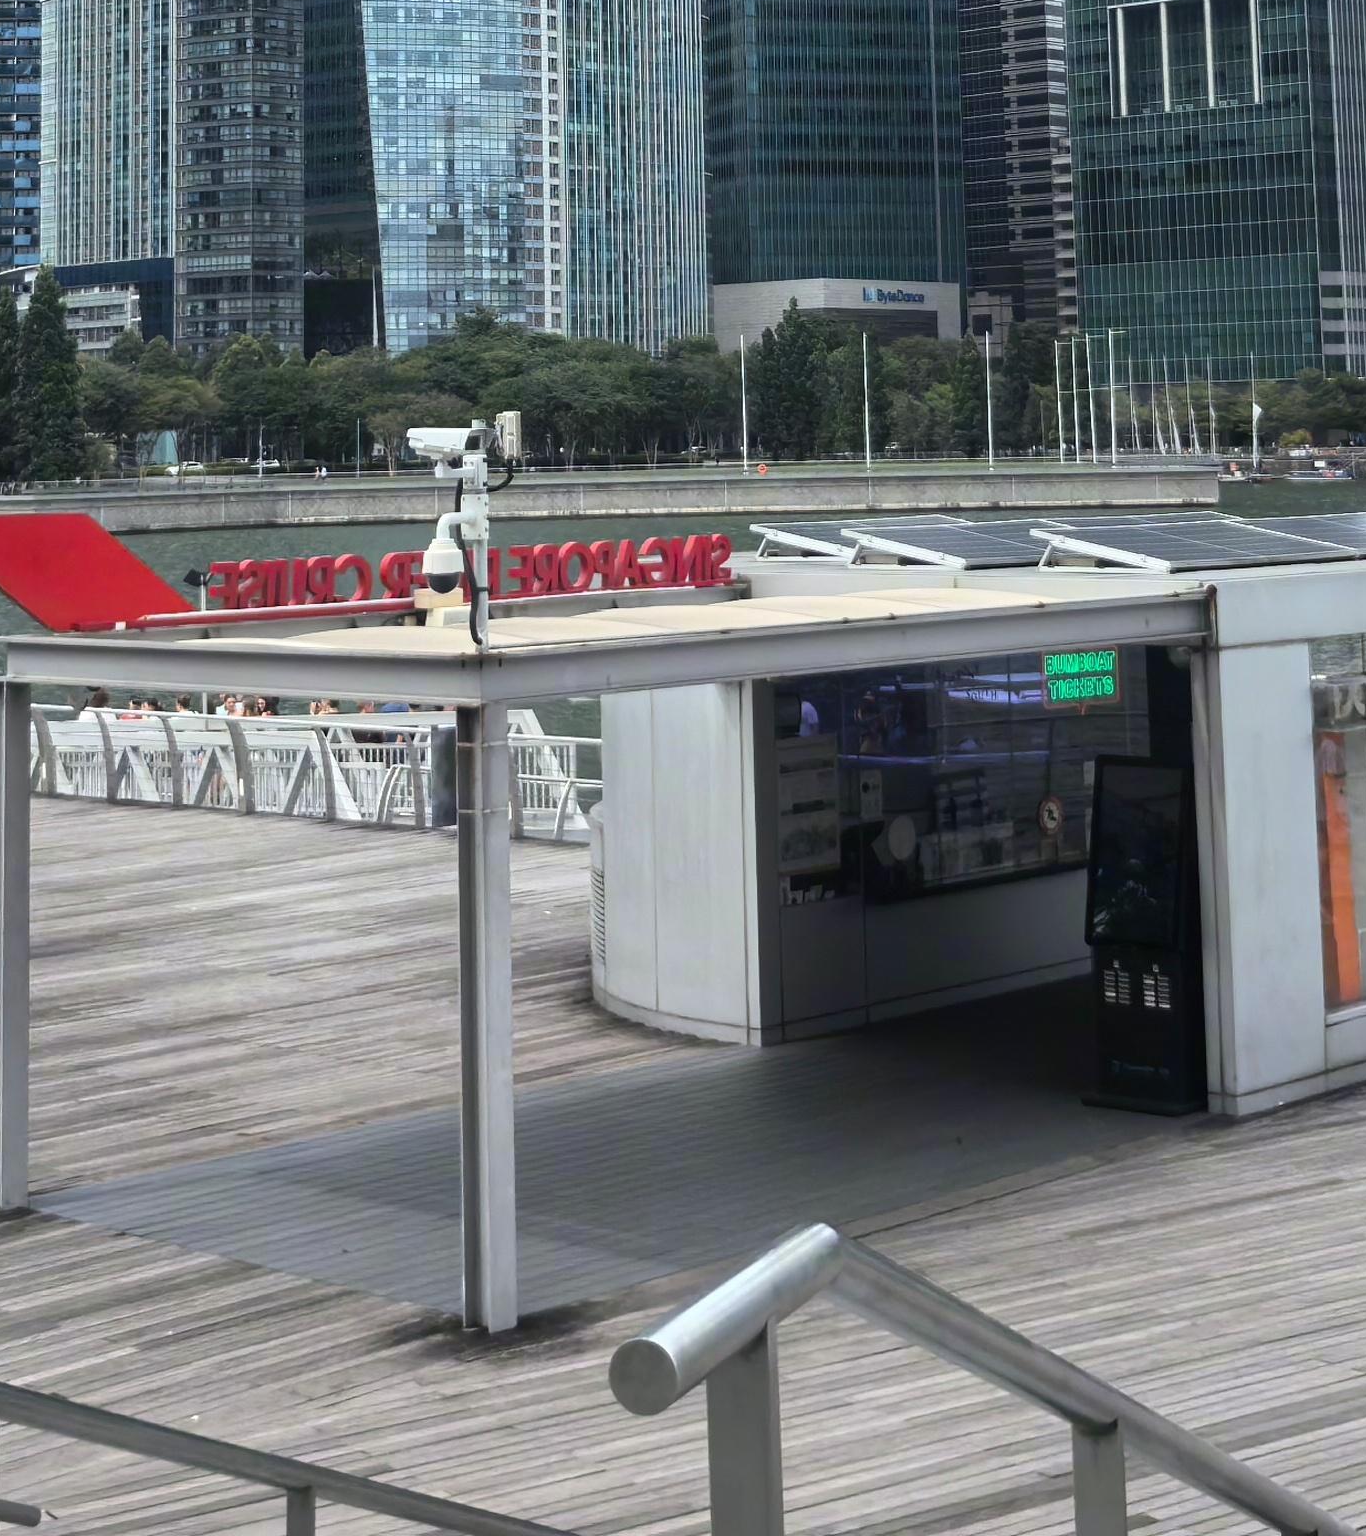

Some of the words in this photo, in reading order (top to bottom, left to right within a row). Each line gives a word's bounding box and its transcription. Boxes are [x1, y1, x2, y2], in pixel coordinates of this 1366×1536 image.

[877, 288, 925, 305] ByteDance
[1044, 650, 1116, 676] BUMBOAT
[1048, 675, 1114, 701] TICKETS
